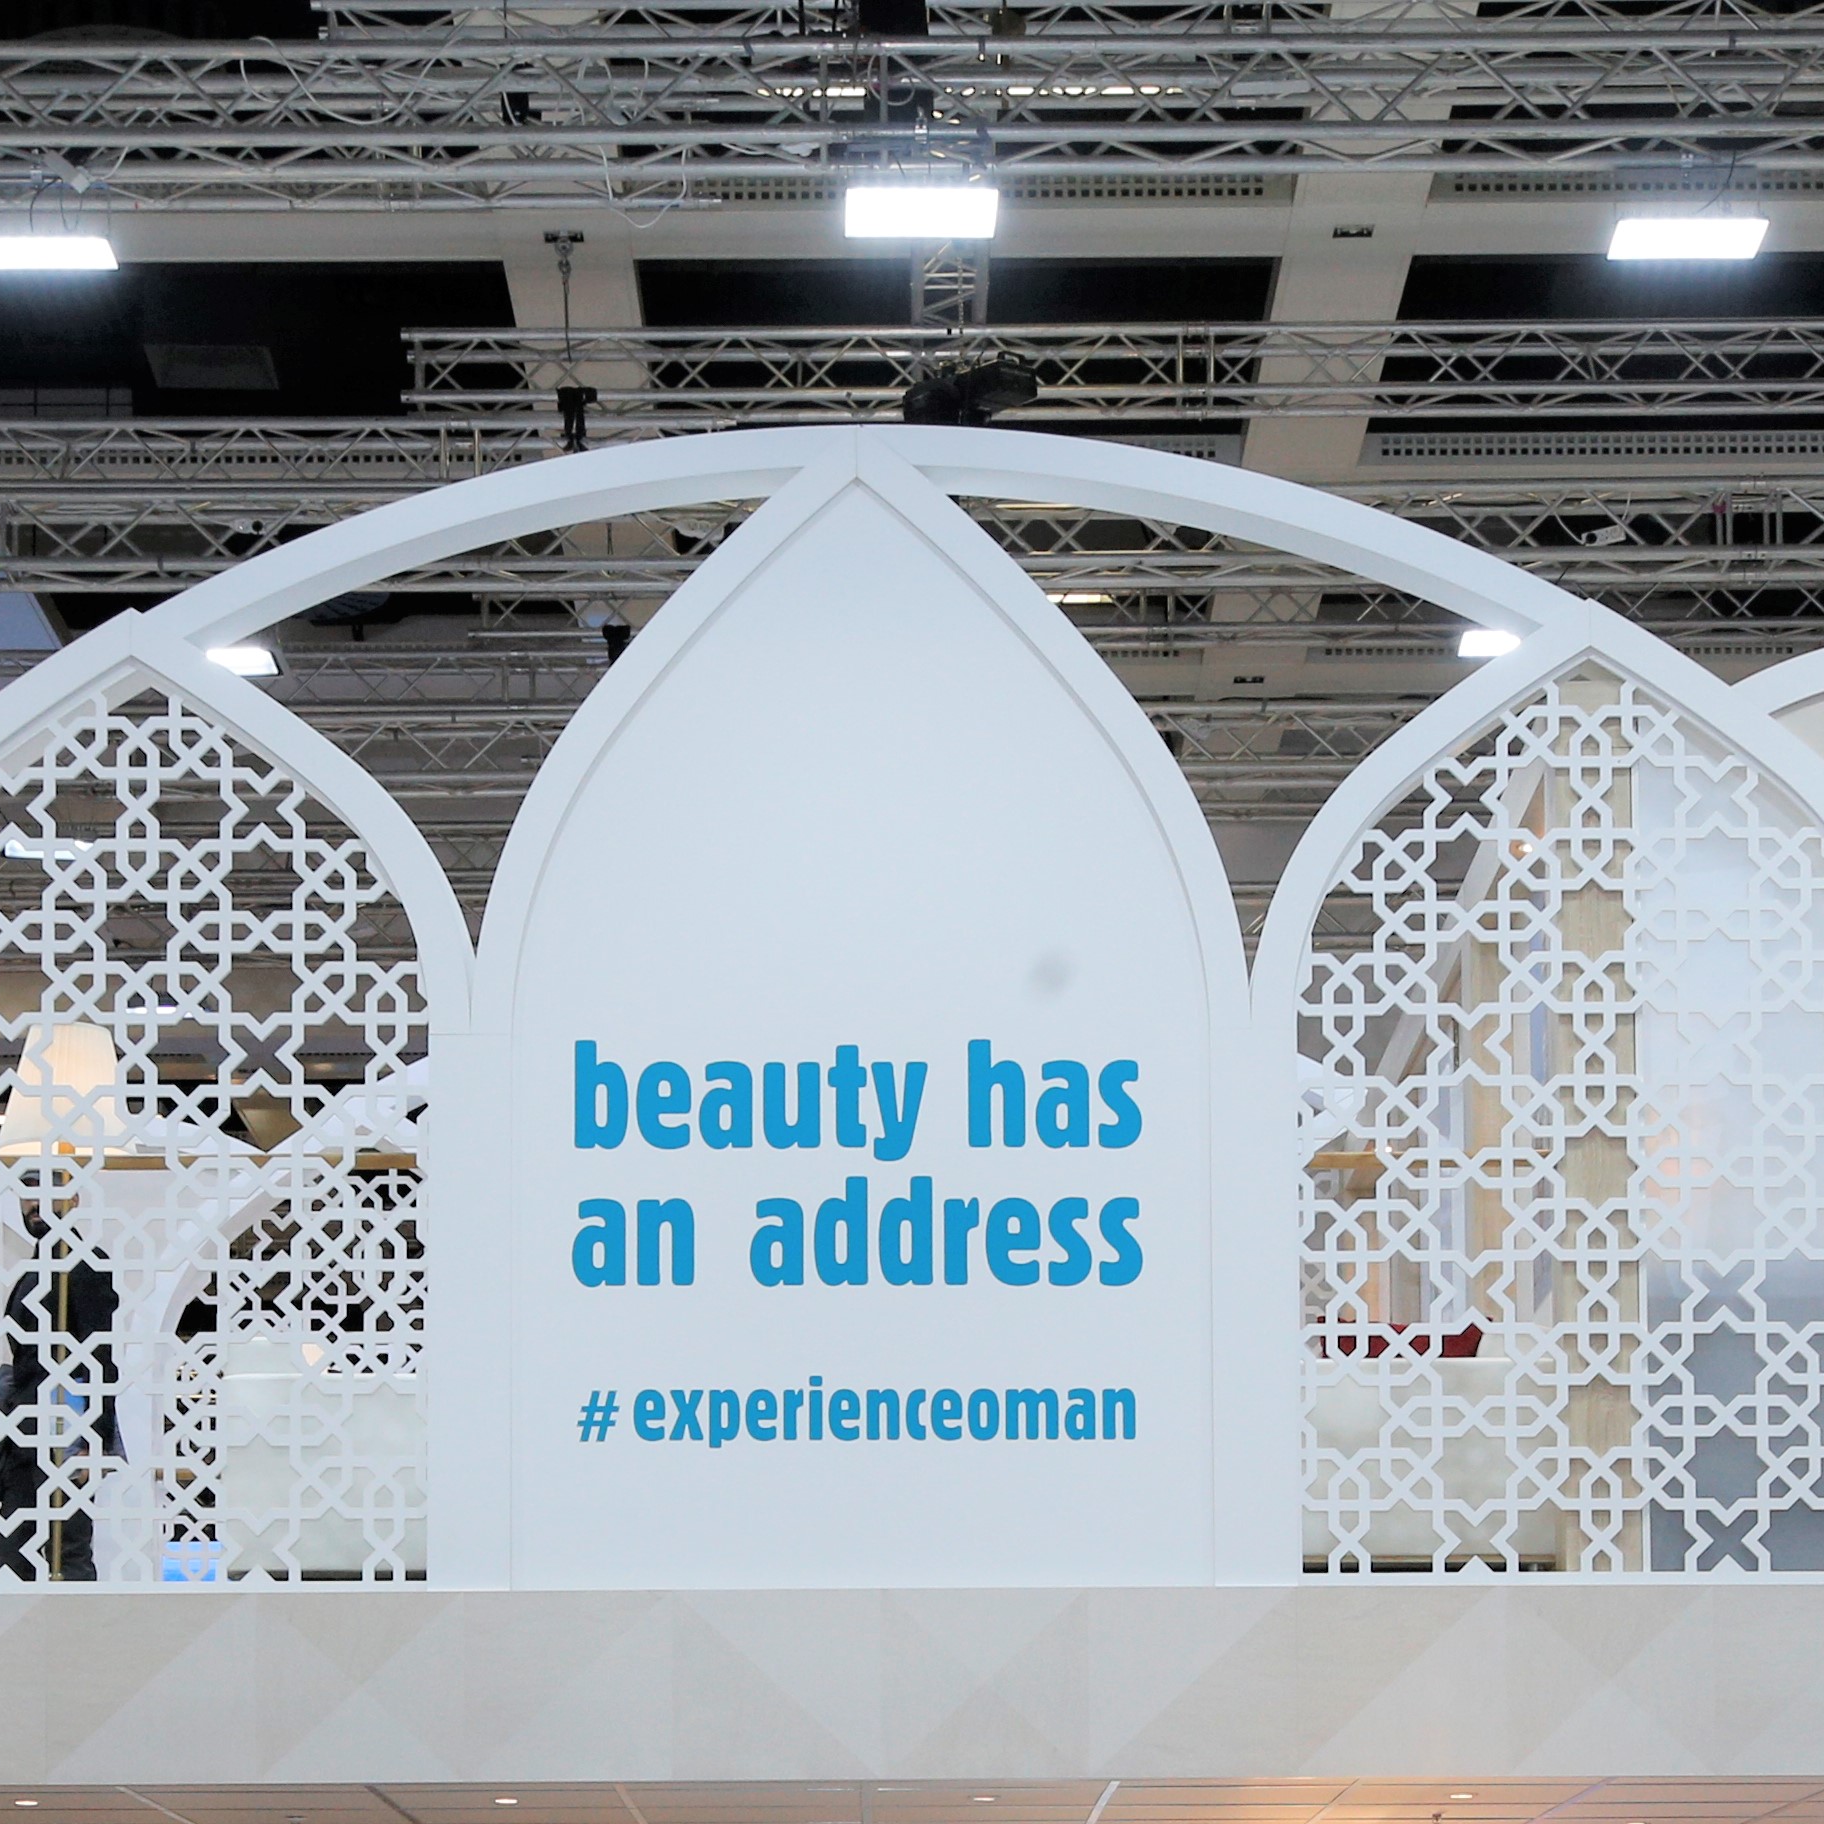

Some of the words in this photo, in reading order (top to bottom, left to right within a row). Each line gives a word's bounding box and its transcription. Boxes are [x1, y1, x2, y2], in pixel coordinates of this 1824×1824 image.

[574, 1040, 928, 1161] beauty
[968, 1039, 1142, 1149] has
[572, 1198, 694, 1287] an
[750, 1176, 1143, 1287] address
